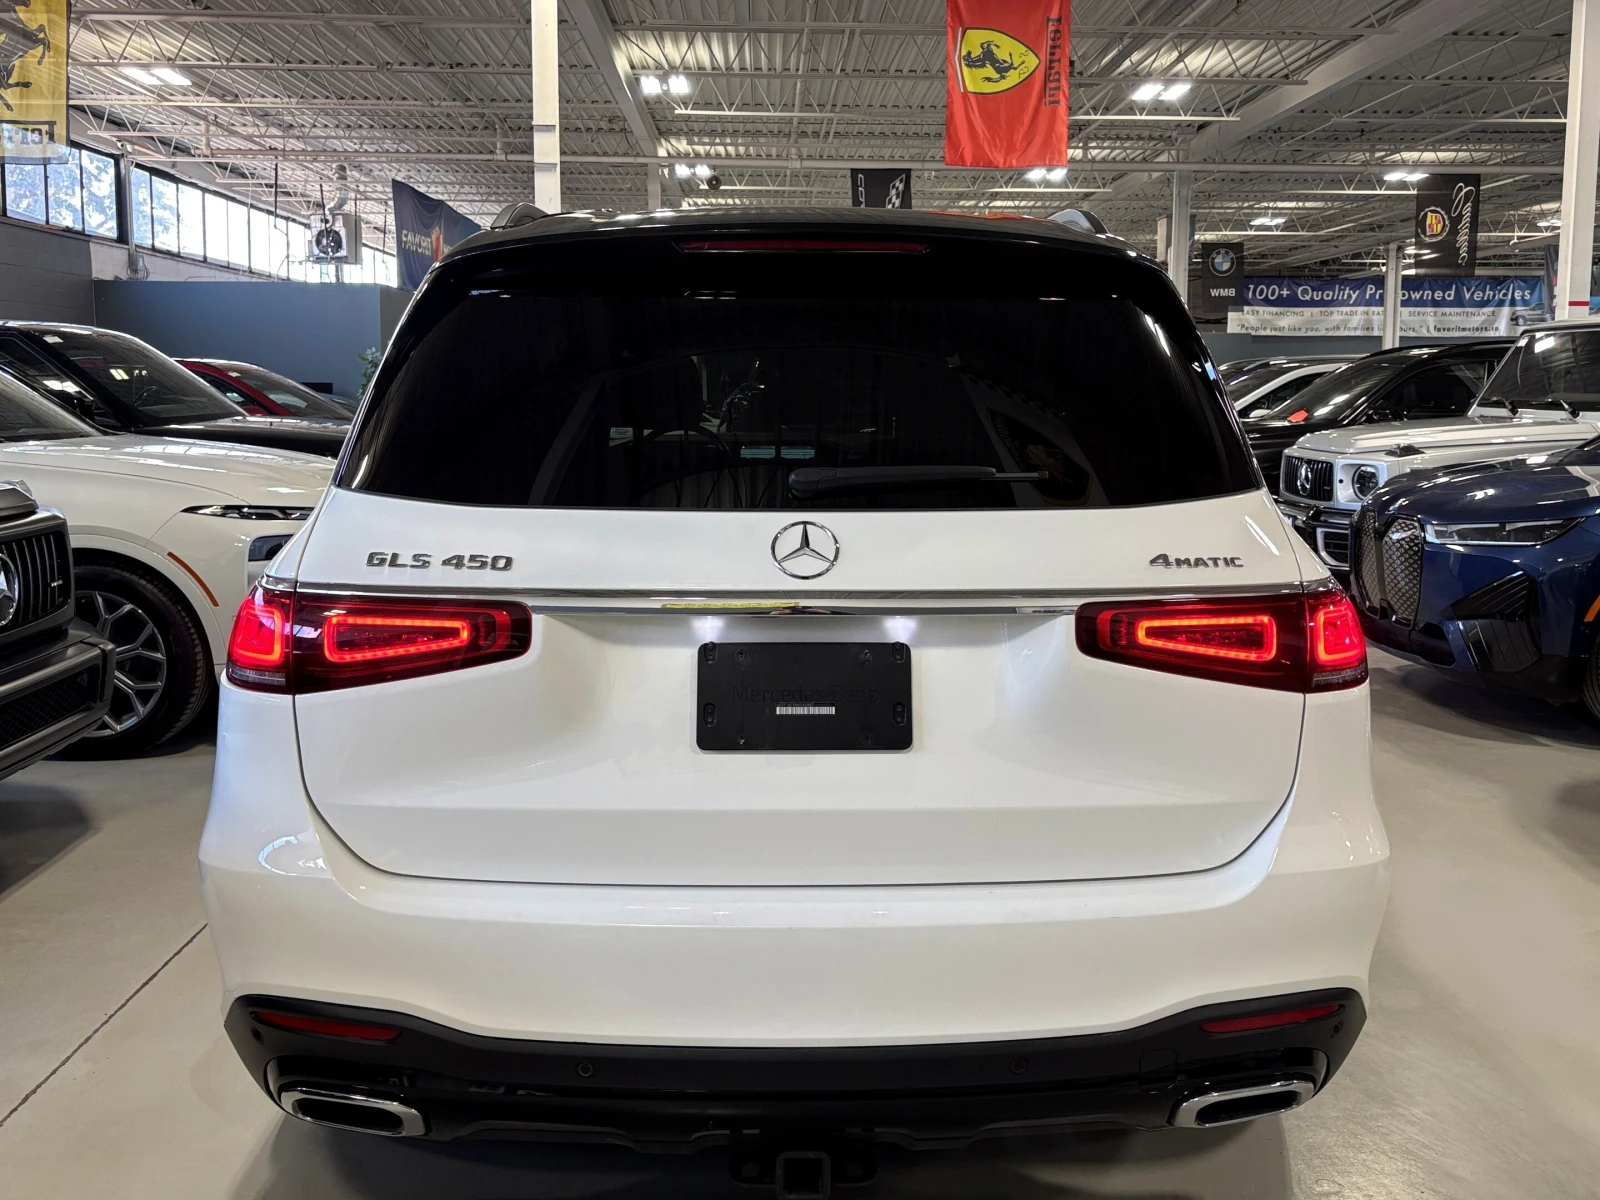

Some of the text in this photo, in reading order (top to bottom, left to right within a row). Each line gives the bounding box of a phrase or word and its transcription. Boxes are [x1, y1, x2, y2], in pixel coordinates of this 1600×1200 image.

[402, 230, 432, 255] FAVORIT
[1248, 284, 1290, 300] 100+
[1298, 284, 1359, 303] Quality
[1463, 283, 1531, 300] Vehicles
[1408, 310, 1438, 318] SERVICE
[1440, 310, 1496, 318] MAINTENANCE
[1270, 324, 1286, 333] just
[1287, 324, 1302, 332] like
[1305, 325, 1321, 334] you,
[1324, 324, 1341, 332] with
[1343, 323, 1375, 332] families
[366, 551, 513, 571] GLS 450
[1149, 553, 1244, 569] 4MATIC
